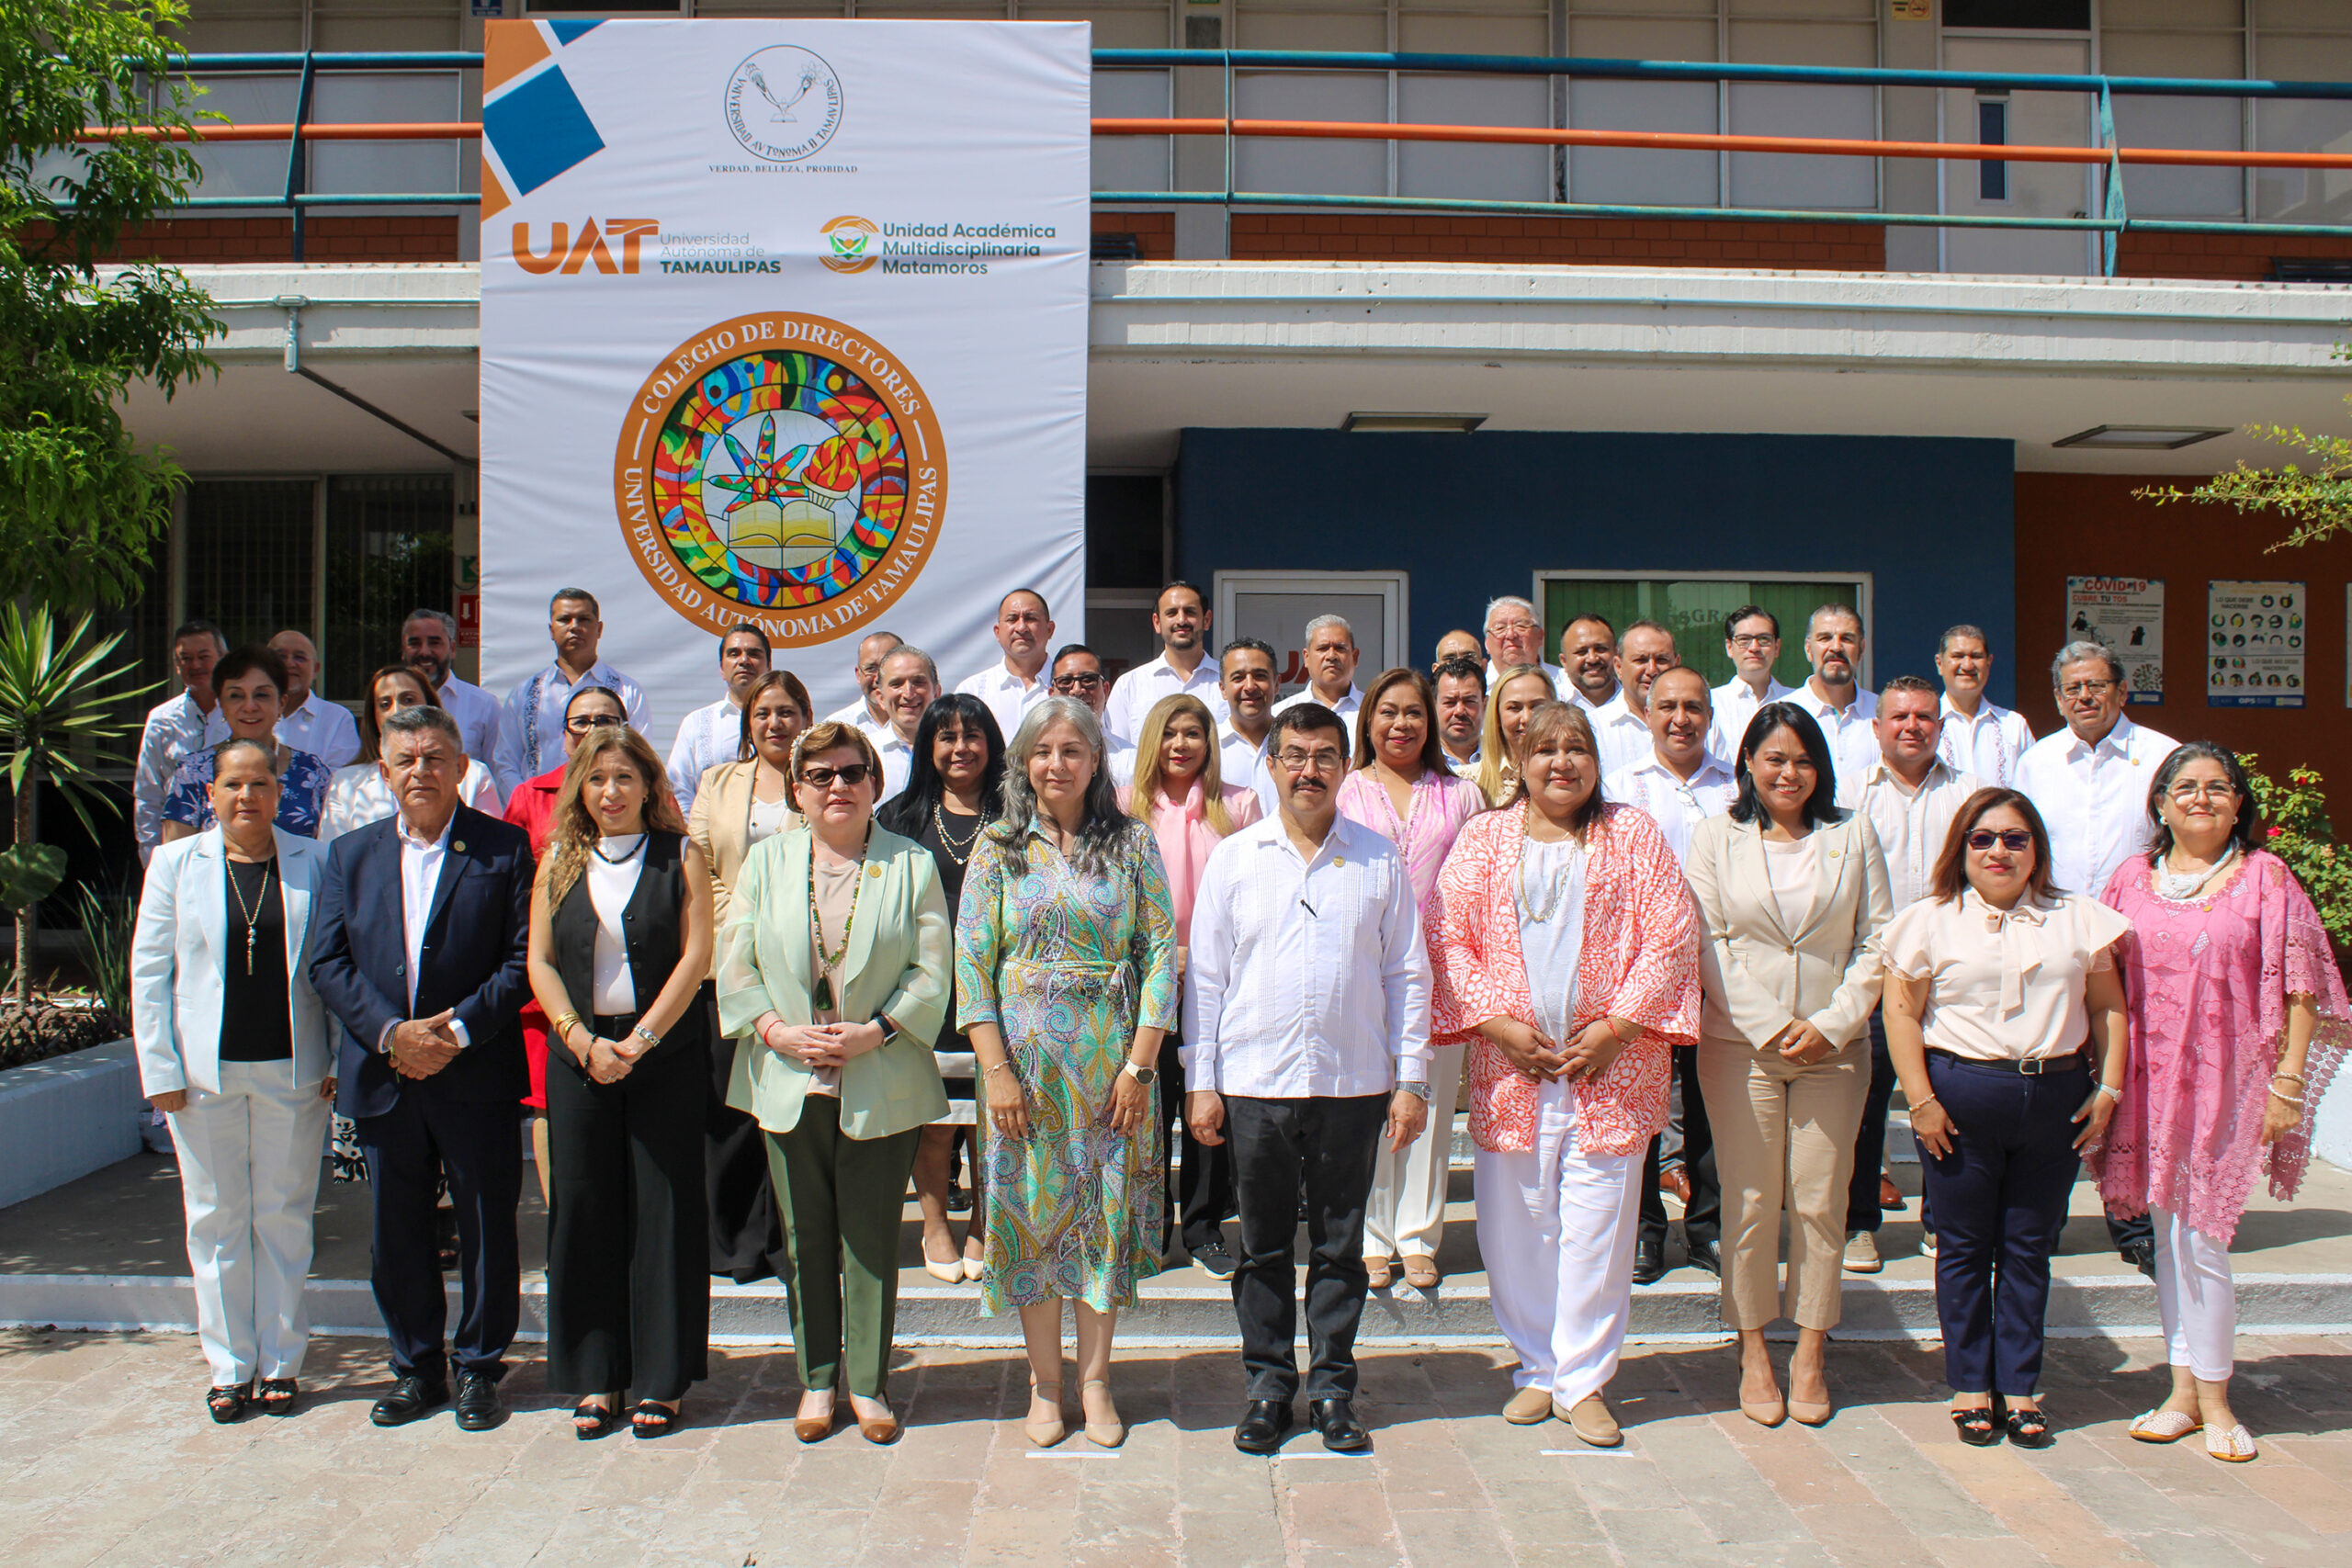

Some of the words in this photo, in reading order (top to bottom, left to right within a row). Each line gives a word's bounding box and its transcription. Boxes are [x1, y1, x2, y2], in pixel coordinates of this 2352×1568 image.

[708, 164, 752, 174] VERDAD,
[755, 164, 804, 174] BELLEZA,
[806, 164, 858, 174] PROBIDAD
[882, 222, 948, 238] Unidad
[953, 222, 1057, 238] Académica
[512, 215, 660, 275] UAT
[660, 232, 750, 245] Universidad
[660, 245, 741, 258] Autónoma
[745, 245, 764, 258] de
[882, 241, 1042, 260] Multidisciplinaria
[660, 260, 782, 274] TAMAULIPAS
[882, 259, 989, 275] Matamoros
[641, 330, 736, 415] COLEGIO
[740, 321, 776, 344] DE
[781, 320, 922, 416] DIRECTORES
[624, 467, 703, 609] UNIVERSIDAD
[834, 594, 871, 626] DE
[864, 466, 938, 603] TAMAULIPAS
[2084, 580, 2147, 592] COVID-19
